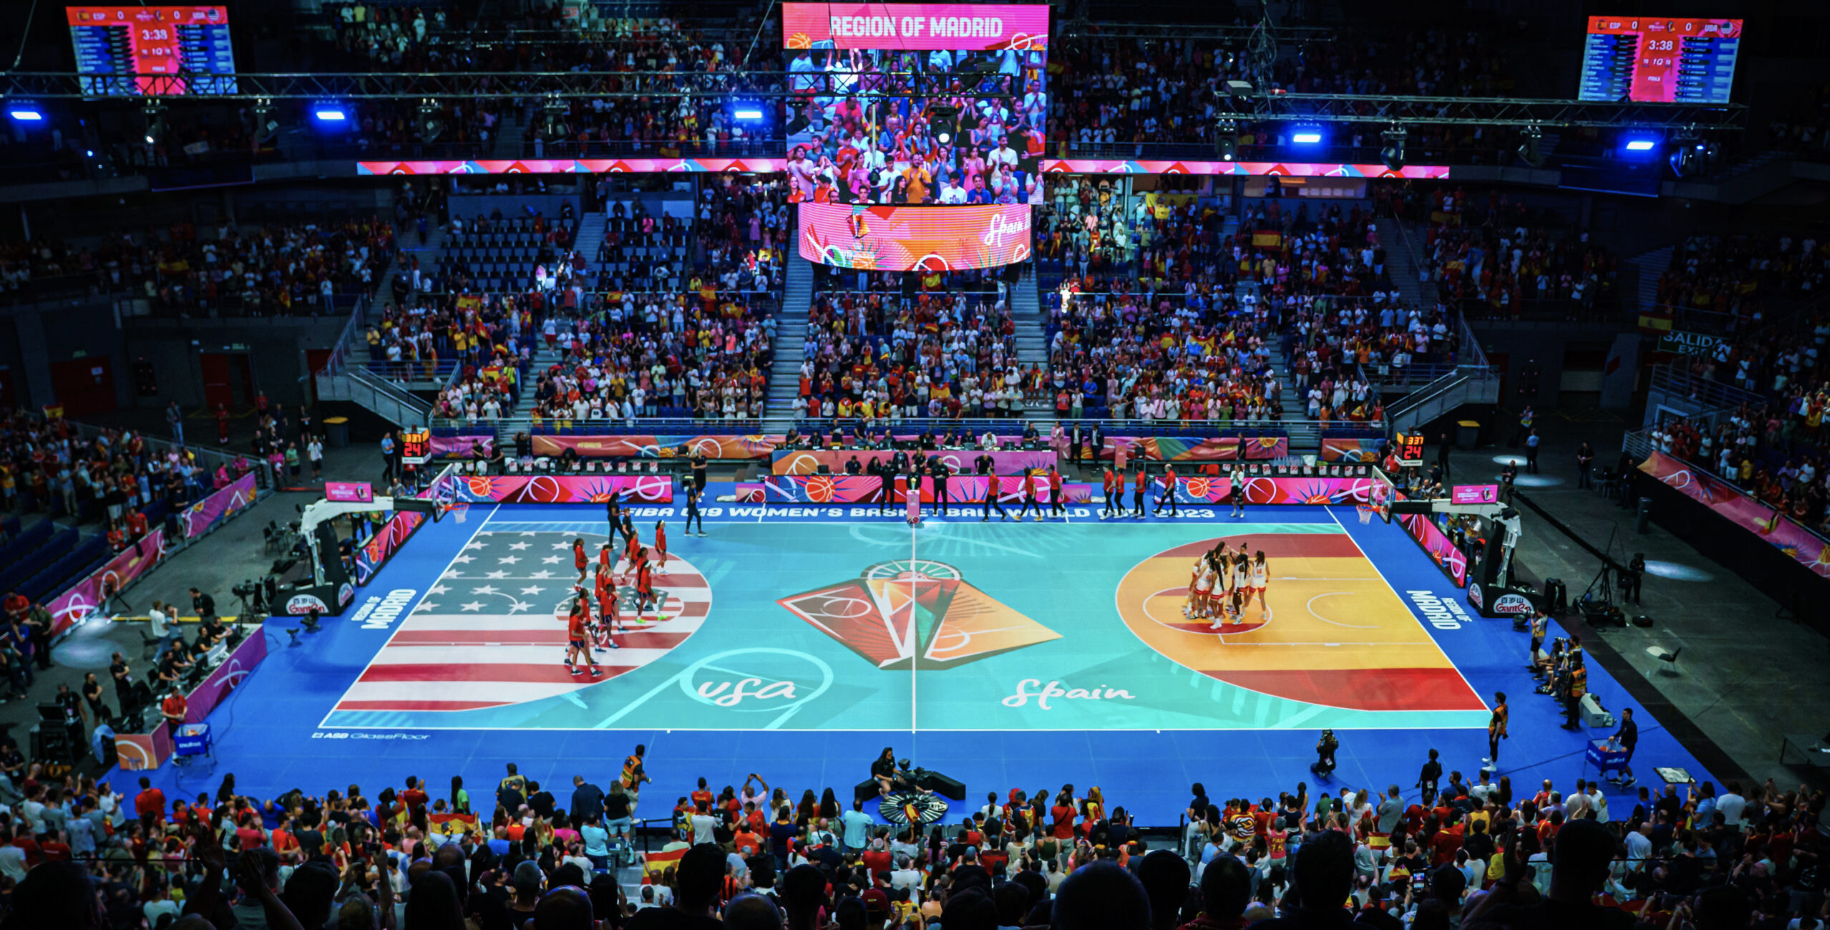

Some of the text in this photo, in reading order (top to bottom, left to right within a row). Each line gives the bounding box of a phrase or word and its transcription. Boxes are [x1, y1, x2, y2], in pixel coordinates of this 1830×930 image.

[117, 10, 124, 20] 0
[174, 10, 181, 20] 0
[830, 16, 1003, 38] REGION OF MADRID
[1609, 22, 1621, 30] ESP
[1631, 20, 1638, 30] 0
[1685, 22, 1718, 32] 0 USA
[142, 29, 169, 41] 3:38
[1648, 39, 1674, 51] 3:38
[984, 213, 1023, 248] Spain
[404, 442, 421, 456] 24
[1403, 445, 1422, 460] 24
[628, 507, 674, 517] FIBA
[729, 507, 843, 517] WOMEN'S
[1153, 508, 1215, 518] 2023
[361, 589, 417, 629] MADRID
[1406, 590, 1461, 630] MADRID
[1001, 678, 1136, 710] Spain
